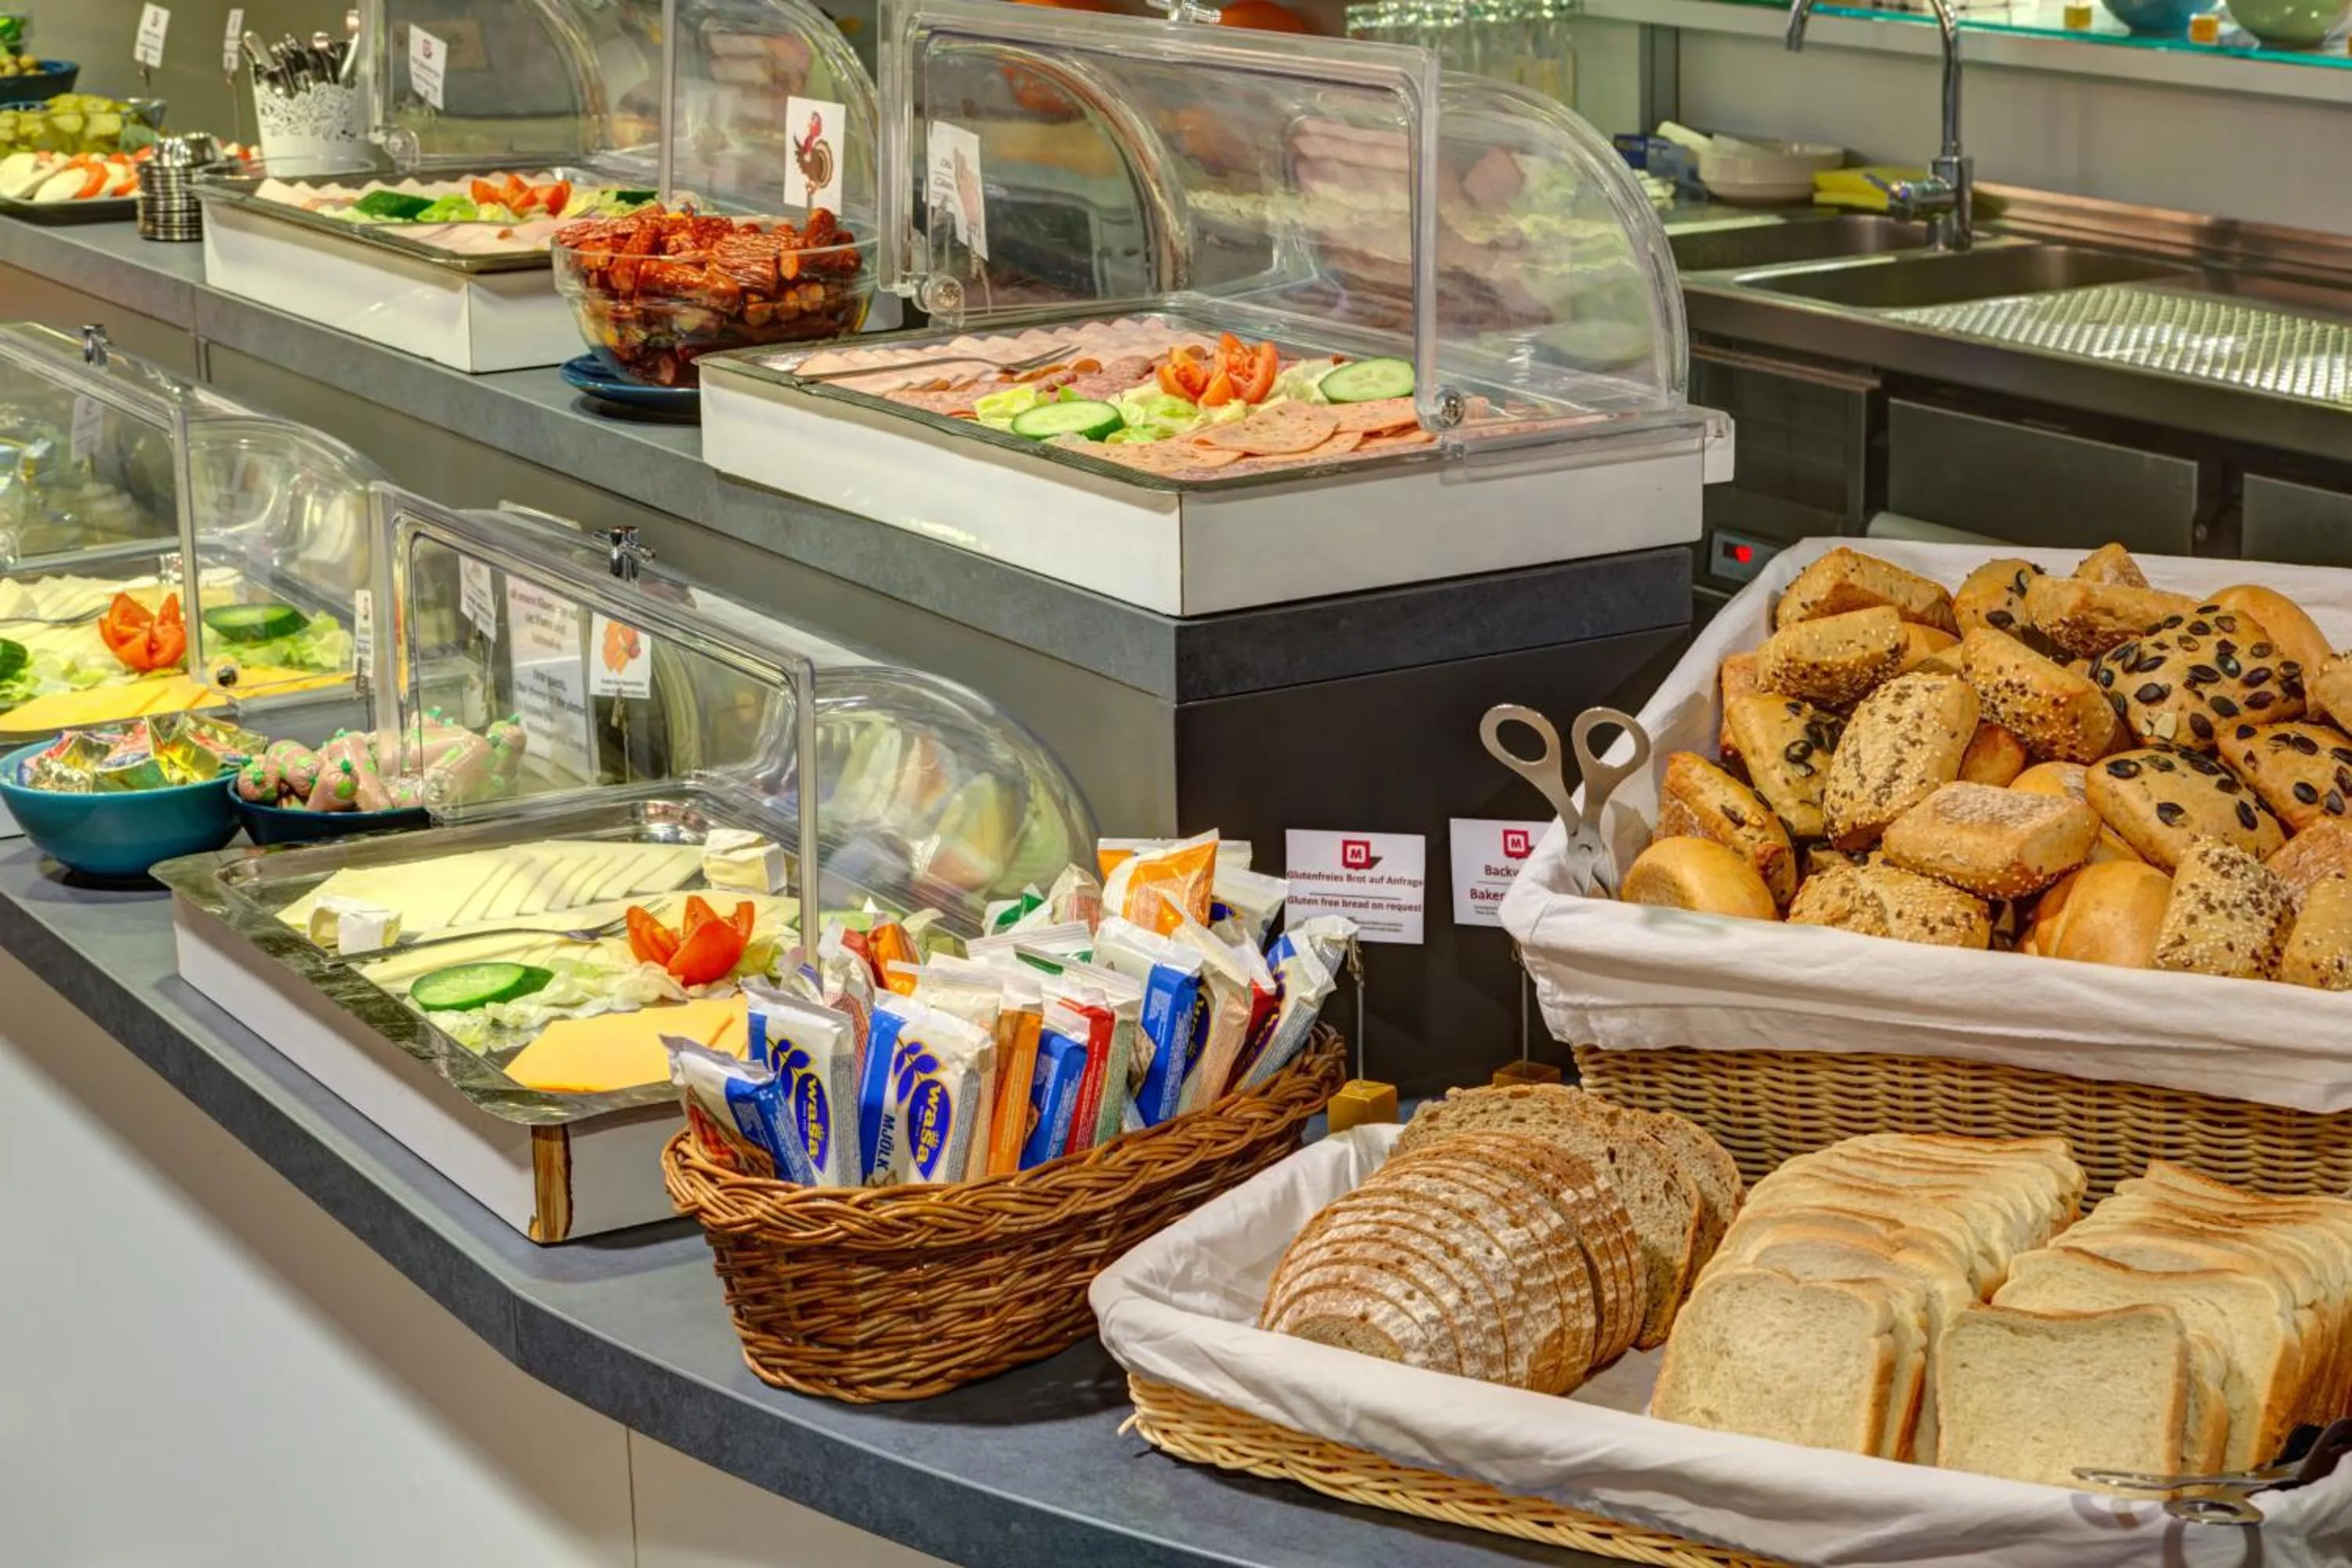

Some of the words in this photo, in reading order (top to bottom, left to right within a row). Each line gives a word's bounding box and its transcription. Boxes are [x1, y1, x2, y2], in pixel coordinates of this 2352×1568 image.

[1350, 848, 1363, 860] M
[1287, 869, 1343, 883] Glutenfreies
[1346, 873, 1367, 884] Brot
[1368, 875, 1384, 885] auf
[1386, 876, 1423, 888] Anfrage
[1470, 887, 1505, 901] Baker
[1287, 895, 1318, 906] Gluten
[1320, 896, 1340, 907] free
[1341, 898, 1369, 909] bread
[1370, 901, 1384, 910] on
[1385, 902, 1422, 913] request
